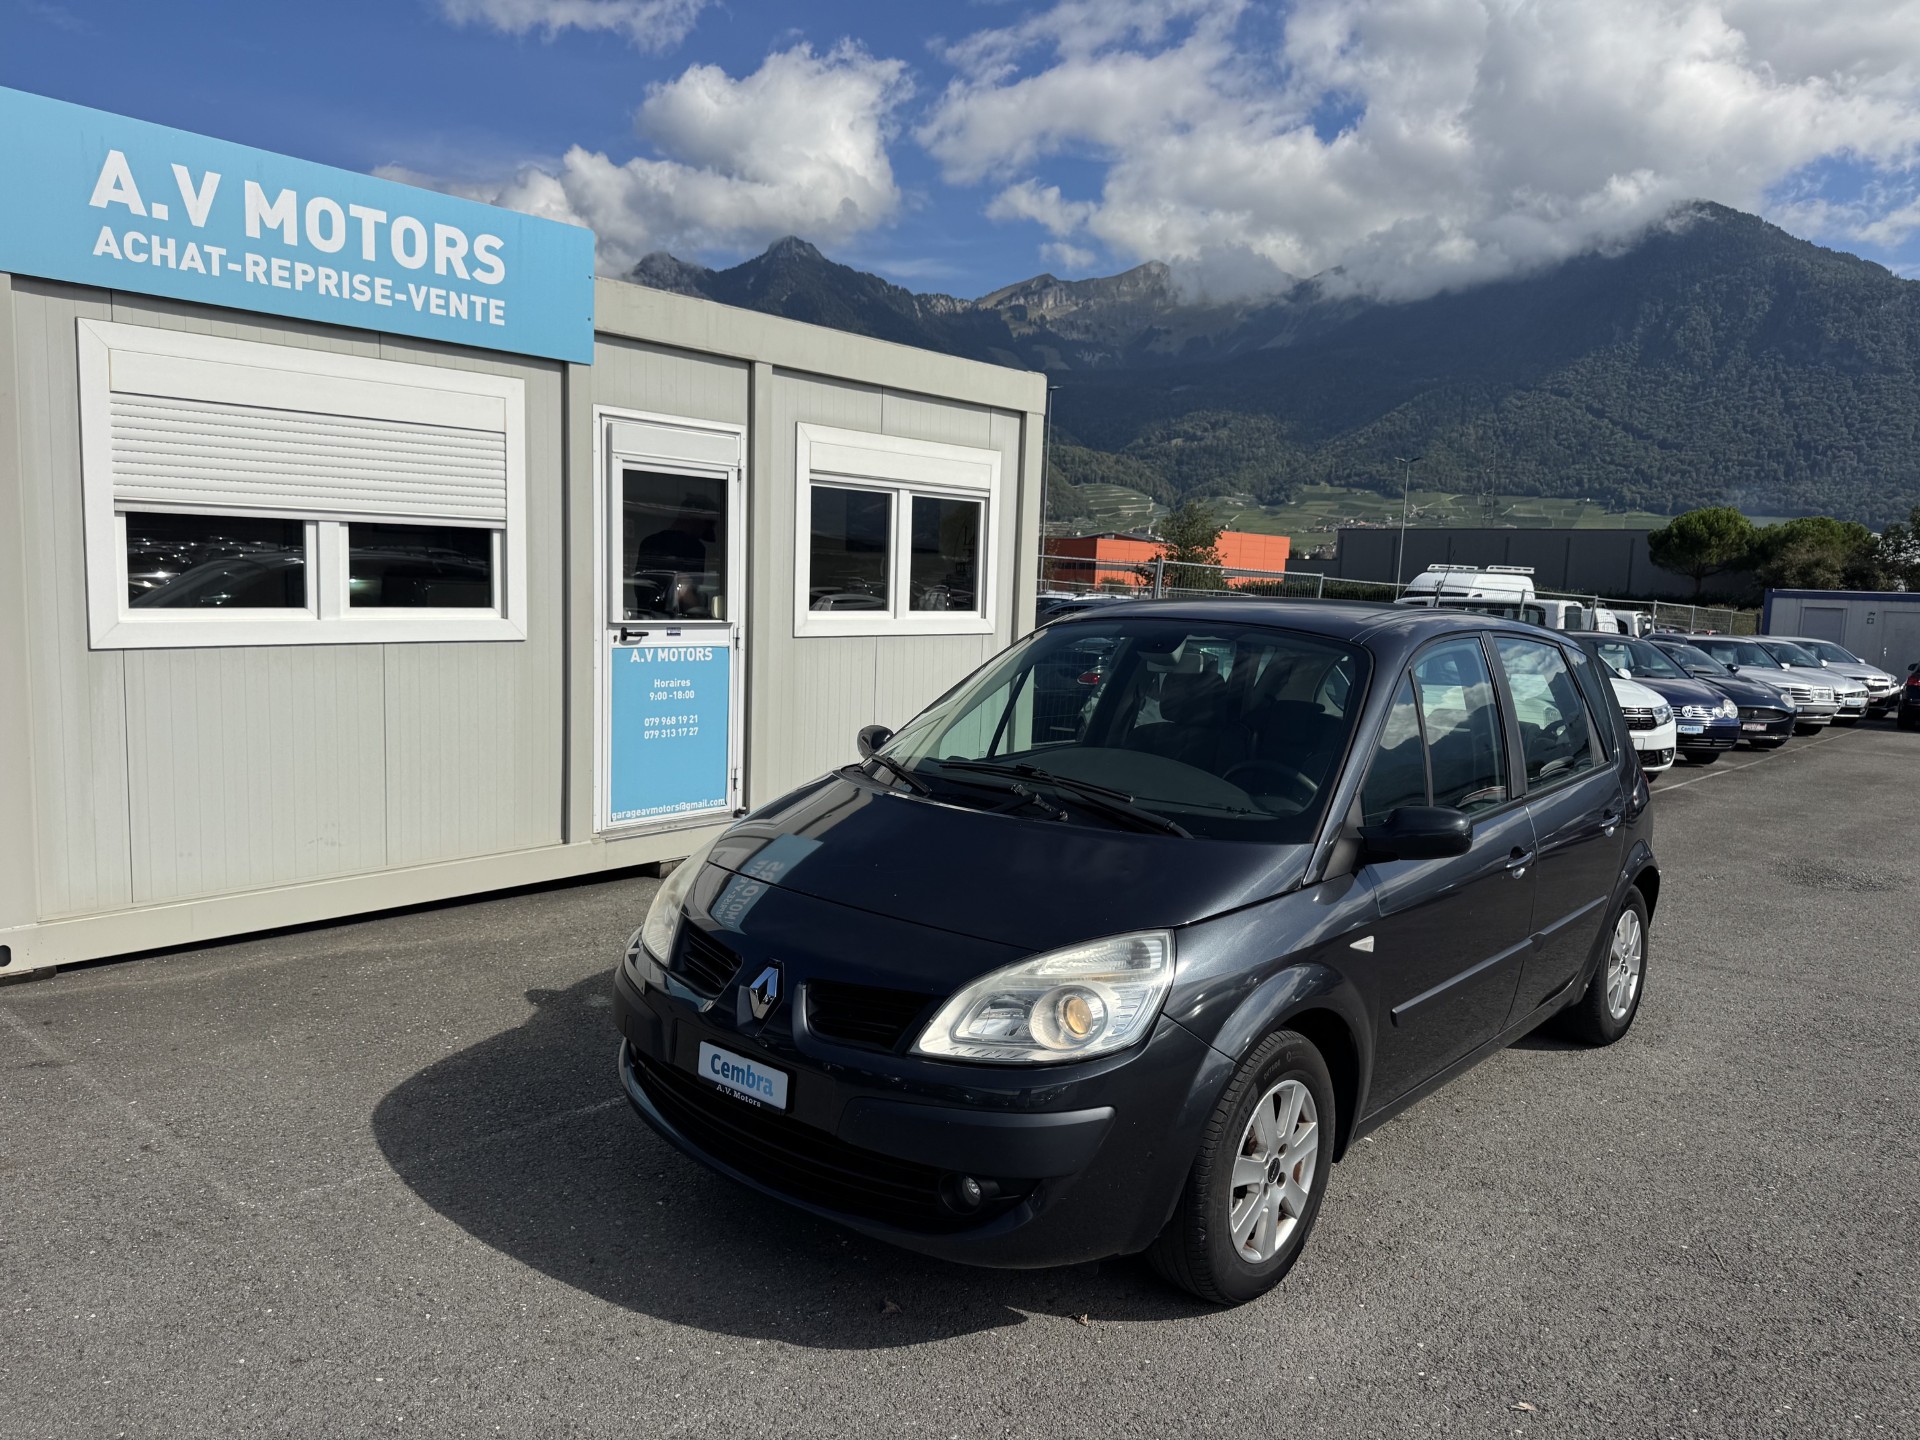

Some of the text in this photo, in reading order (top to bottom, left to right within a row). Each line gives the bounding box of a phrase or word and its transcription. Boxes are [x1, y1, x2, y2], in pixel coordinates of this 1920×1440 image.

[88, 148, 506, 287] A.V MOTORS
[92, 225, 506, 327] ACHAT-REPRISE-VENTE
[630, 647, 713, 663] A.V MOTORS
[653, 678, 691, 688] Horaires
[649, 691, 668, 701] 9:00
[644, 714, 698, 727] 079 968 19 21
[644, 727, 699, 740] 079 313 17 27
[611, 798, 726, 821] garageavmotors@gmail.com
[710, 1053, 774, 1098] Cembra
[716, 1083, 761, 1108] A.V. Motors
